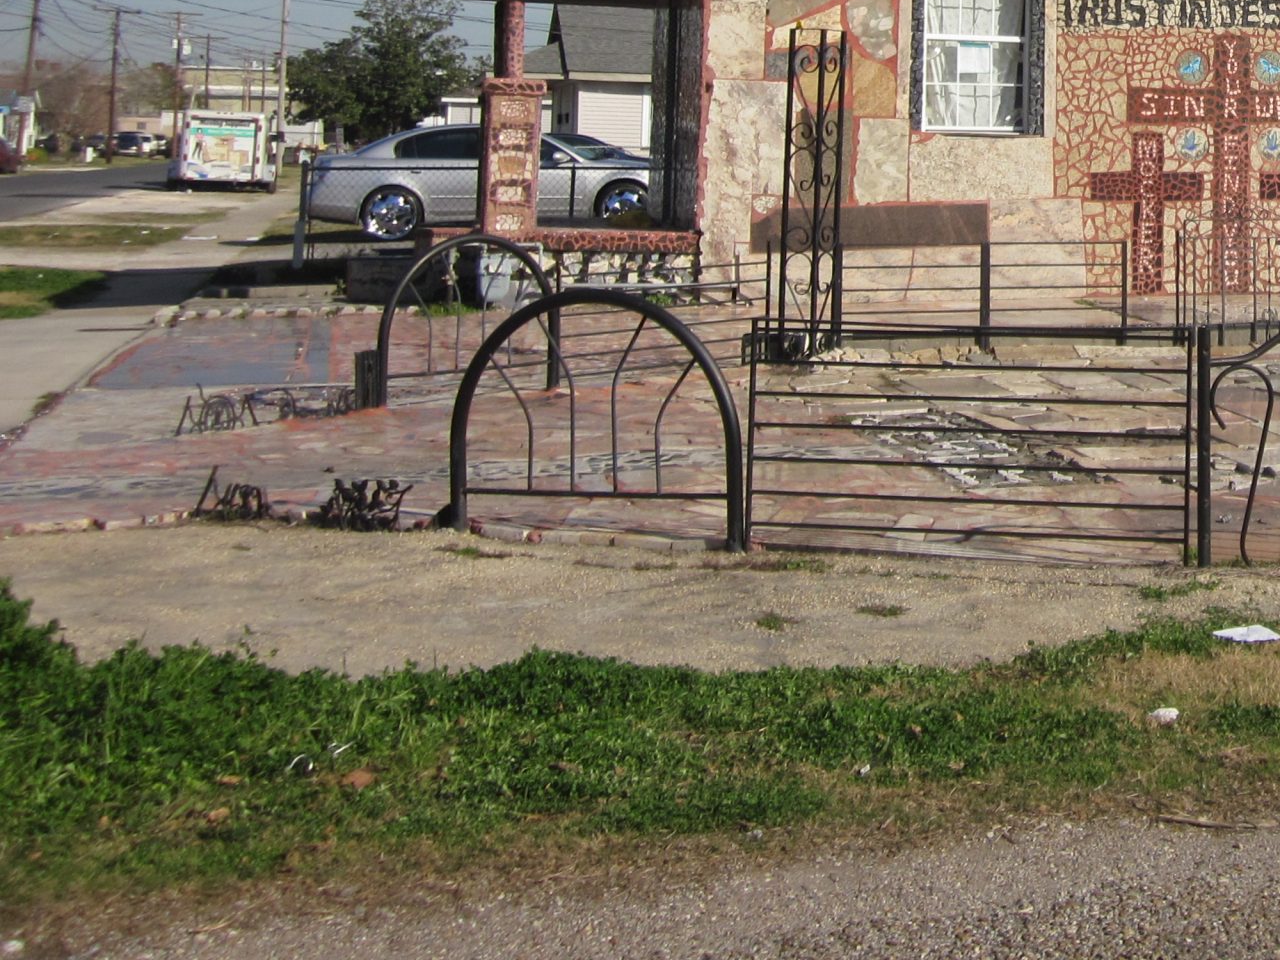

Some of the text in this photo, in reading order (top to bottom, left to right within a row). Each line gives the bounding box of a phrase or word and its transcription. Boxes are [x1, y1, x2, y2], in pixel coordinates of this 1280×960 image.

[1141, 92, 1205, 117] SIN
[1222, 40, 1241, 286] YOUR FIND YOU
[1138, 139, 1157, 273] MOCKER
